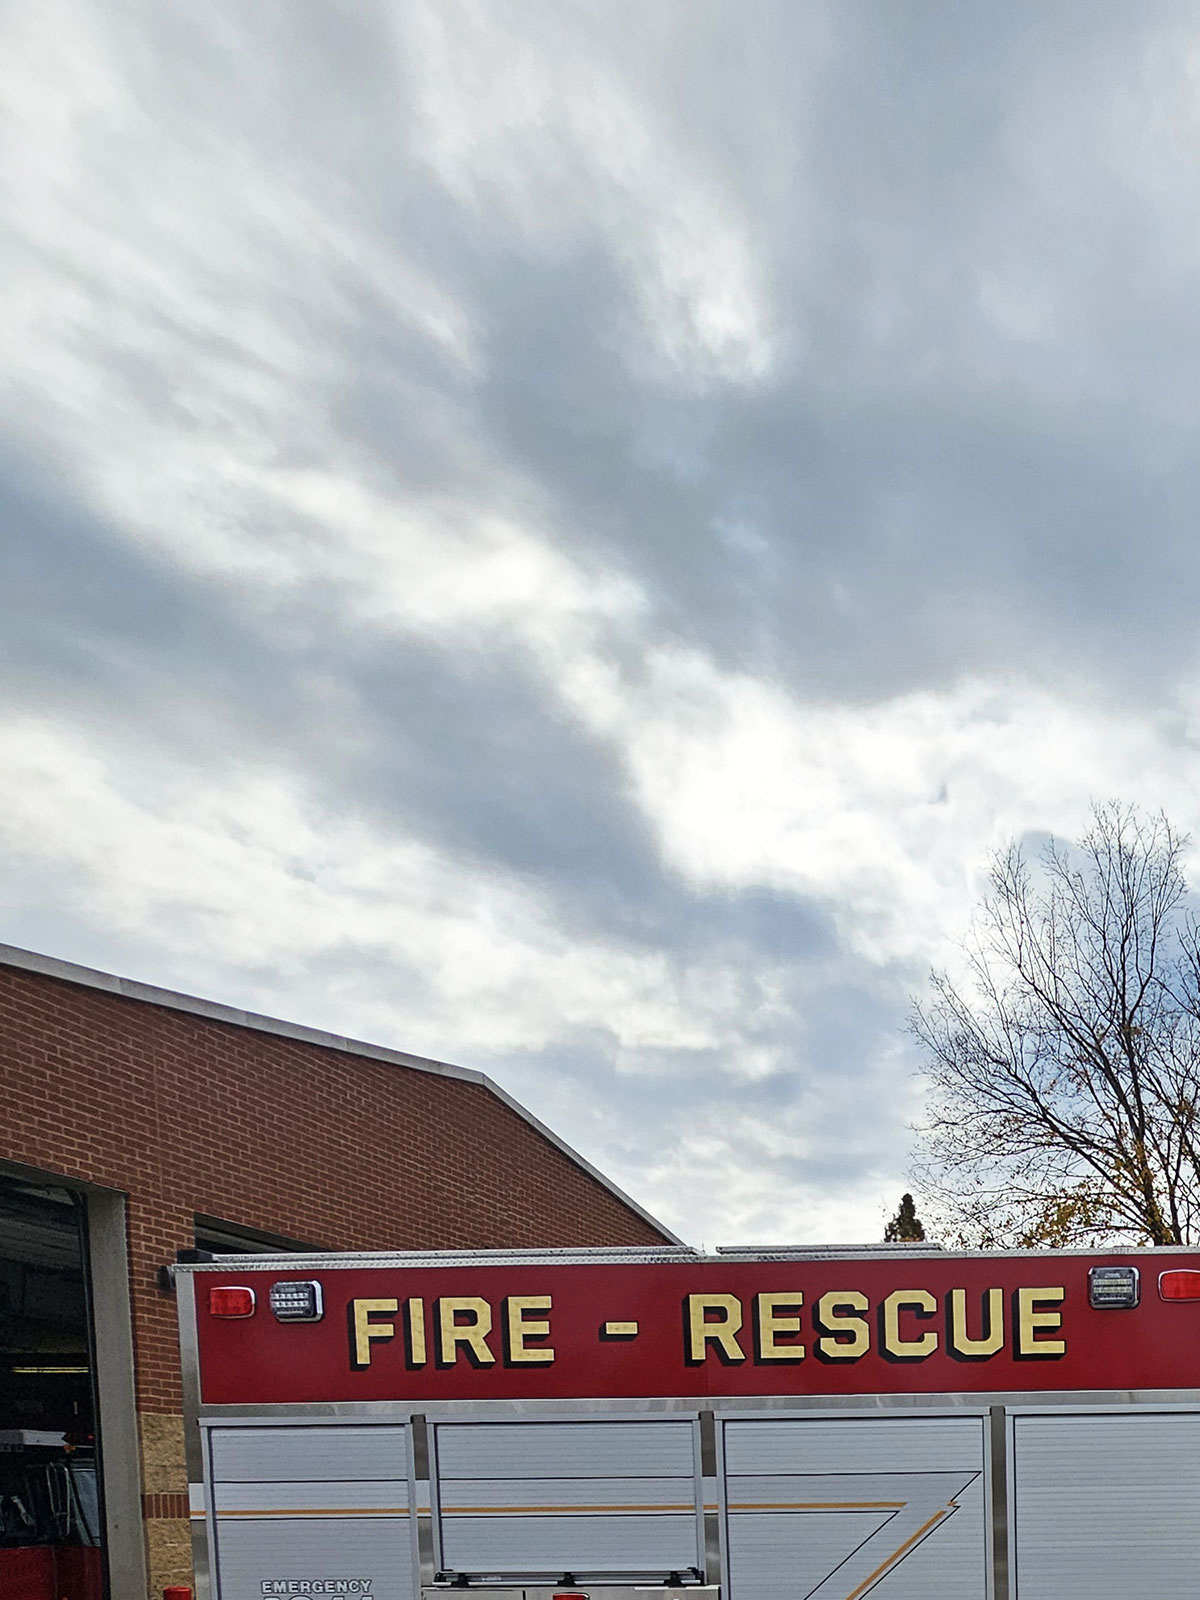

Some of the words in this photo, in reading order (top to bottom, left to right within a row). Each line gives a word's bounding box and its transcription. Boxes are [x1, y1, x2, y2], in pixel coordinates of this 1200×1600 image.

[349, 1296, 555, 1369] FIRE
[685, 1286, 1067, 1364] RESCUE
[261, 1579, 372, 1594] EMERGENCY
